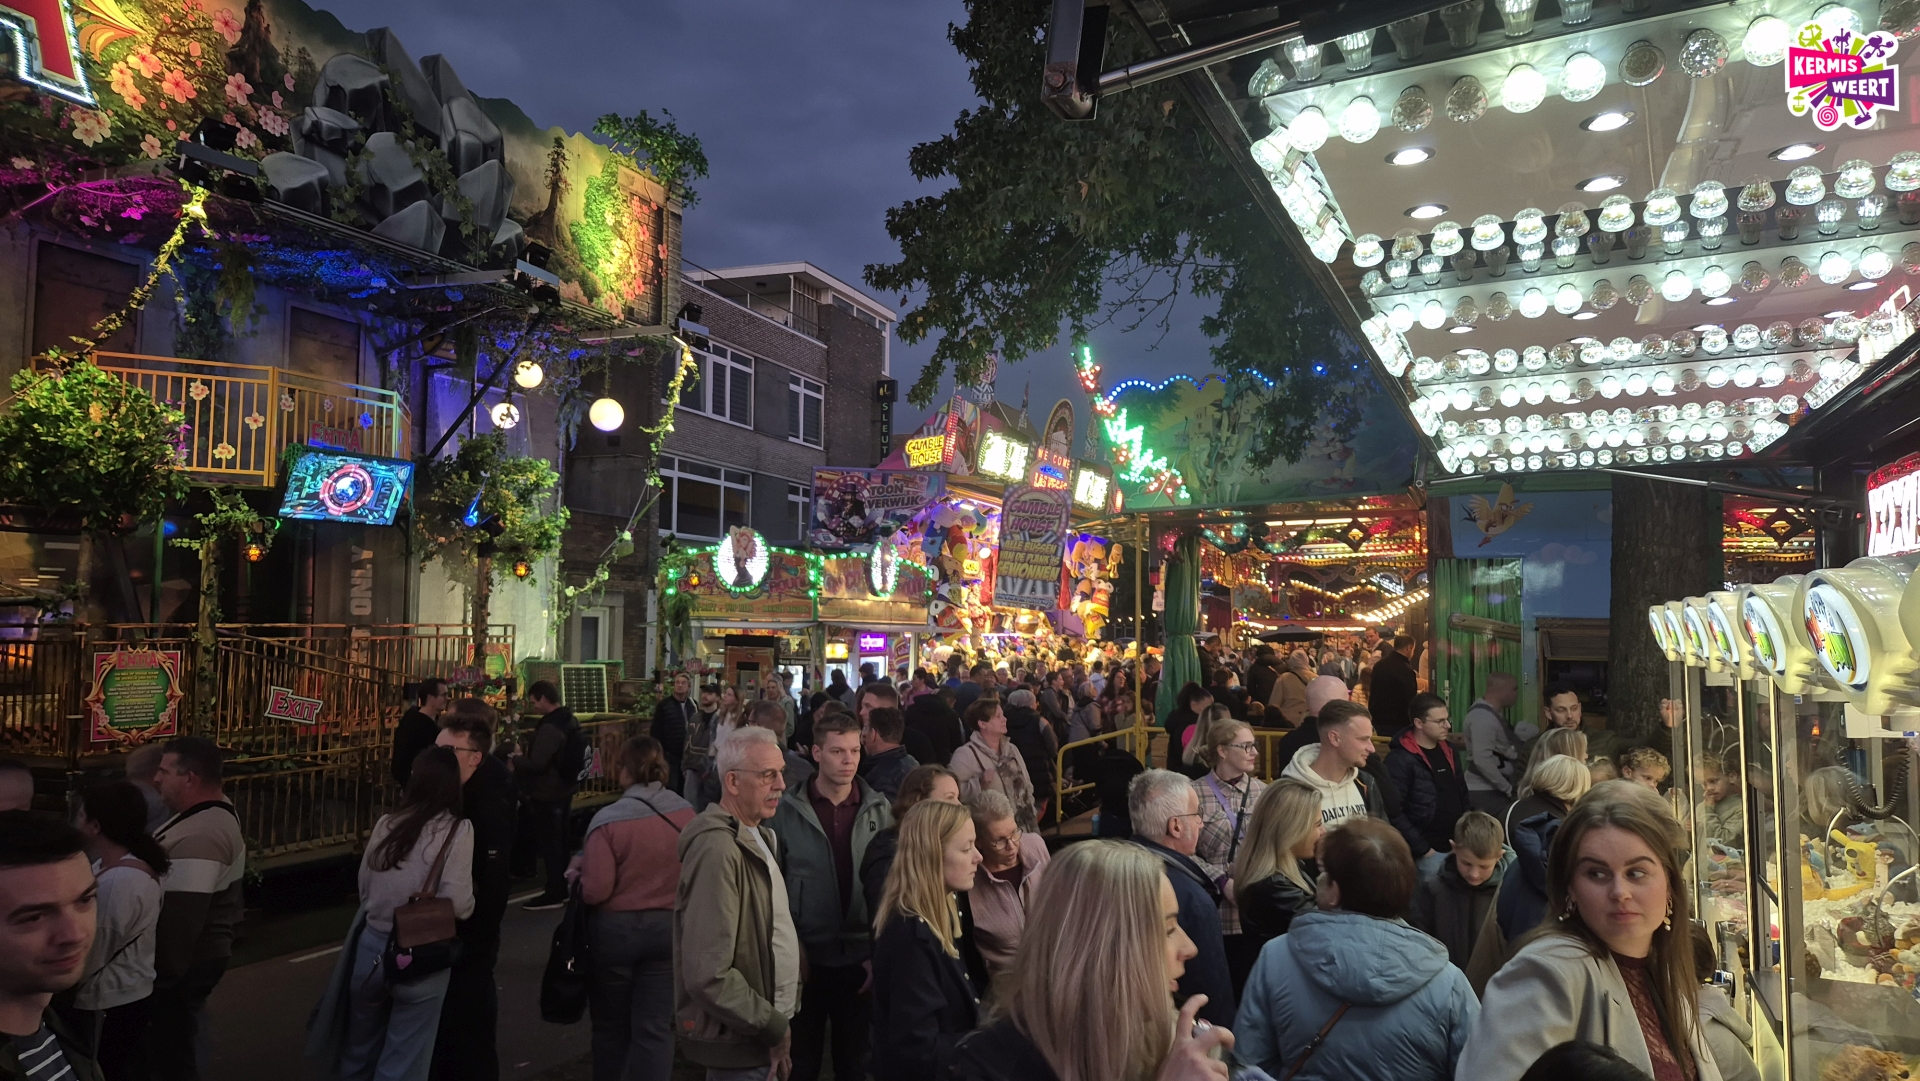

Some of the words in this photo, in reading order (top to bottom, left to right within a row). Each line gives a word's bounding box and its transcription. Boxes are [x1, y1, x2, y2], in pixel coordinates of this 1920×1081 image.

[309, 421, 362, 453] ENTIA
[905, 434, 945, 455] GAMBLE
[910, 449, 943, 468] HOUSE
[869, 484, 904, 497] TOON
[866, 494, 921, 510] VERWIJK
[1009, 500, 1063, 516] GAMBLE
[1010, 516, 1055, 532] HOUSE
[1004, 540, 1024, 551] ALLE
[1024, 541, 1058, 554] BUSSEN
[998, 561, 1061, 581] GEWONNEN
[350, 545, 374, 616] ONLY
[116, 652, 159, 668] ENTIA
[270, 689, 320, 720] EXIT
[1321, 806, 1346, 823] DAILY
